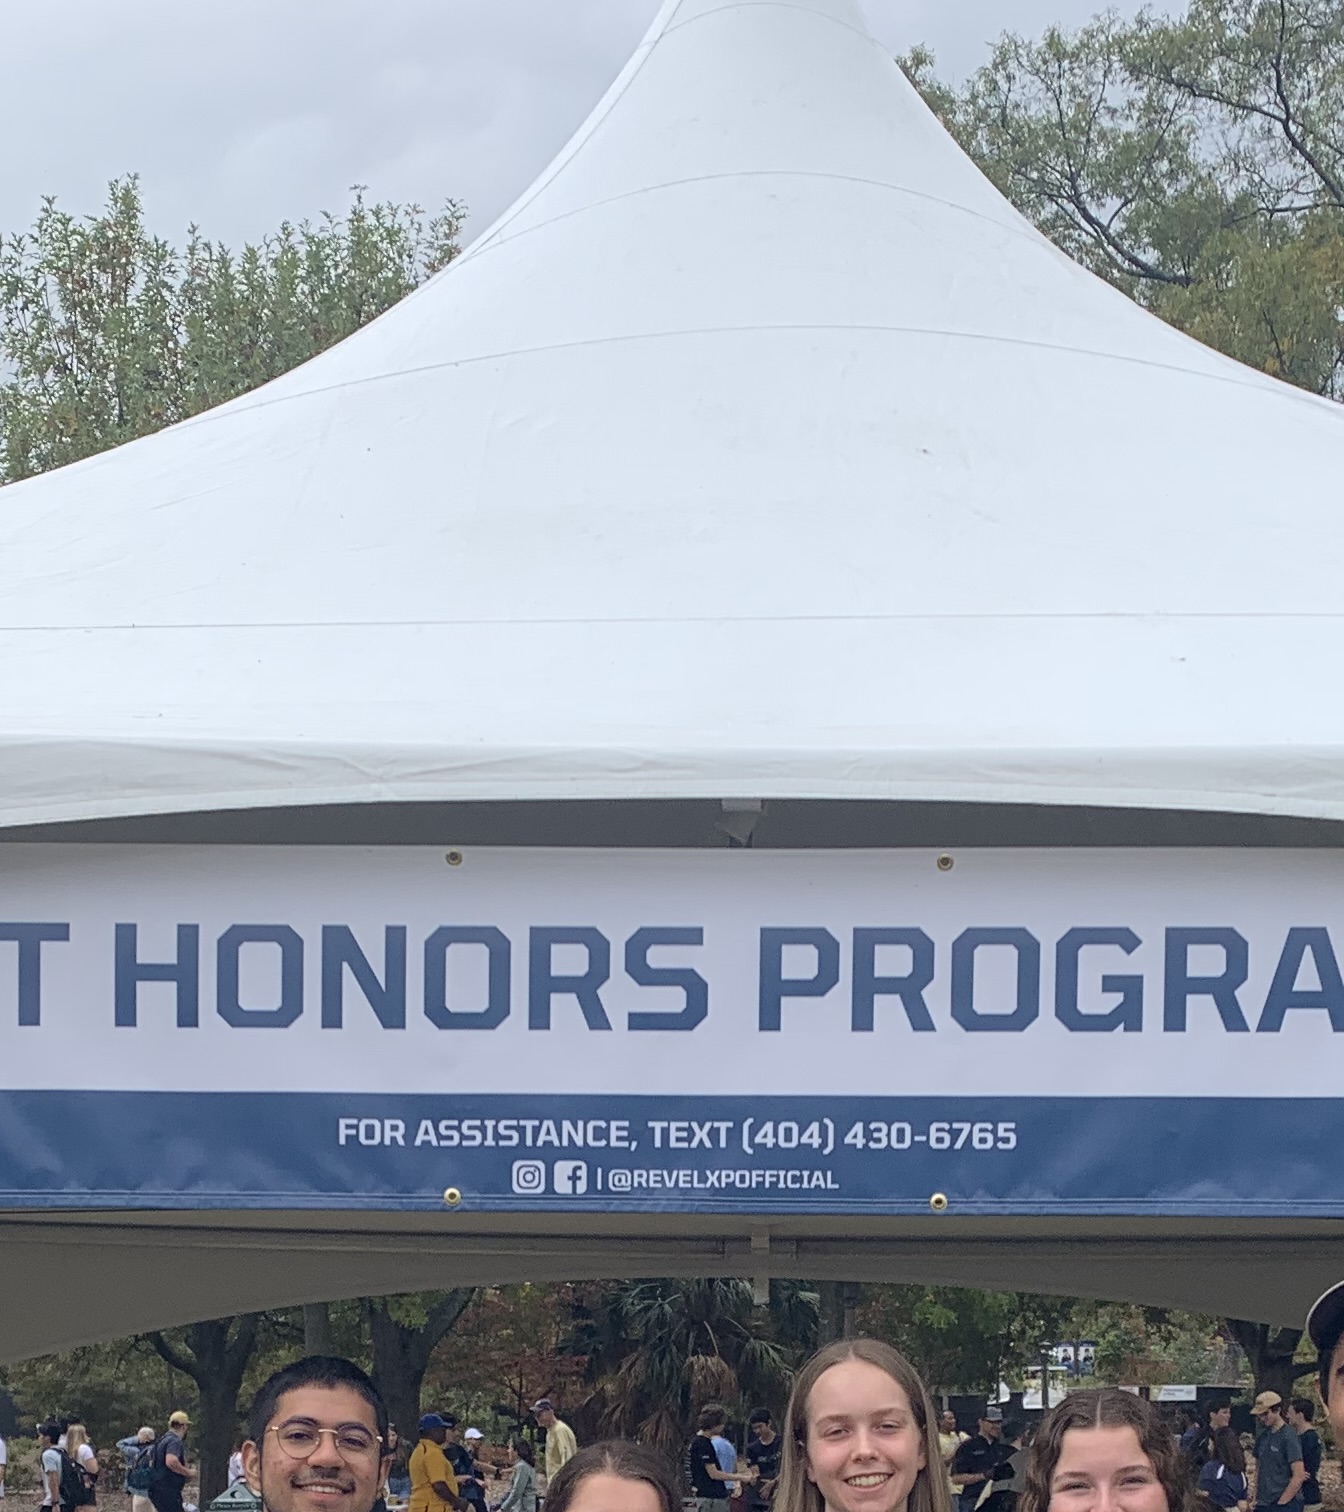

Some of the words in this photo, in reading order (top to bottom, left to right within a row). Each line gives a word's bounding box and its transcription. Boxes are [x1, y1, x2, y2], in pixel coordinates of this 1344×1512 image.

[115, 922, 709, 1032] HONORS
[339, 1118, 405, 1146] FOR
[414, 1119, 638, 1152] ASSISTANCE,
[647, 1121, 734, 1149] TEXT
[742, 1117, 835, 1155] (404)
[844, 1121, 1017, 1150] 430-6765
[608, 1169, 840, 1192] @REVELXPOFFICIAL
